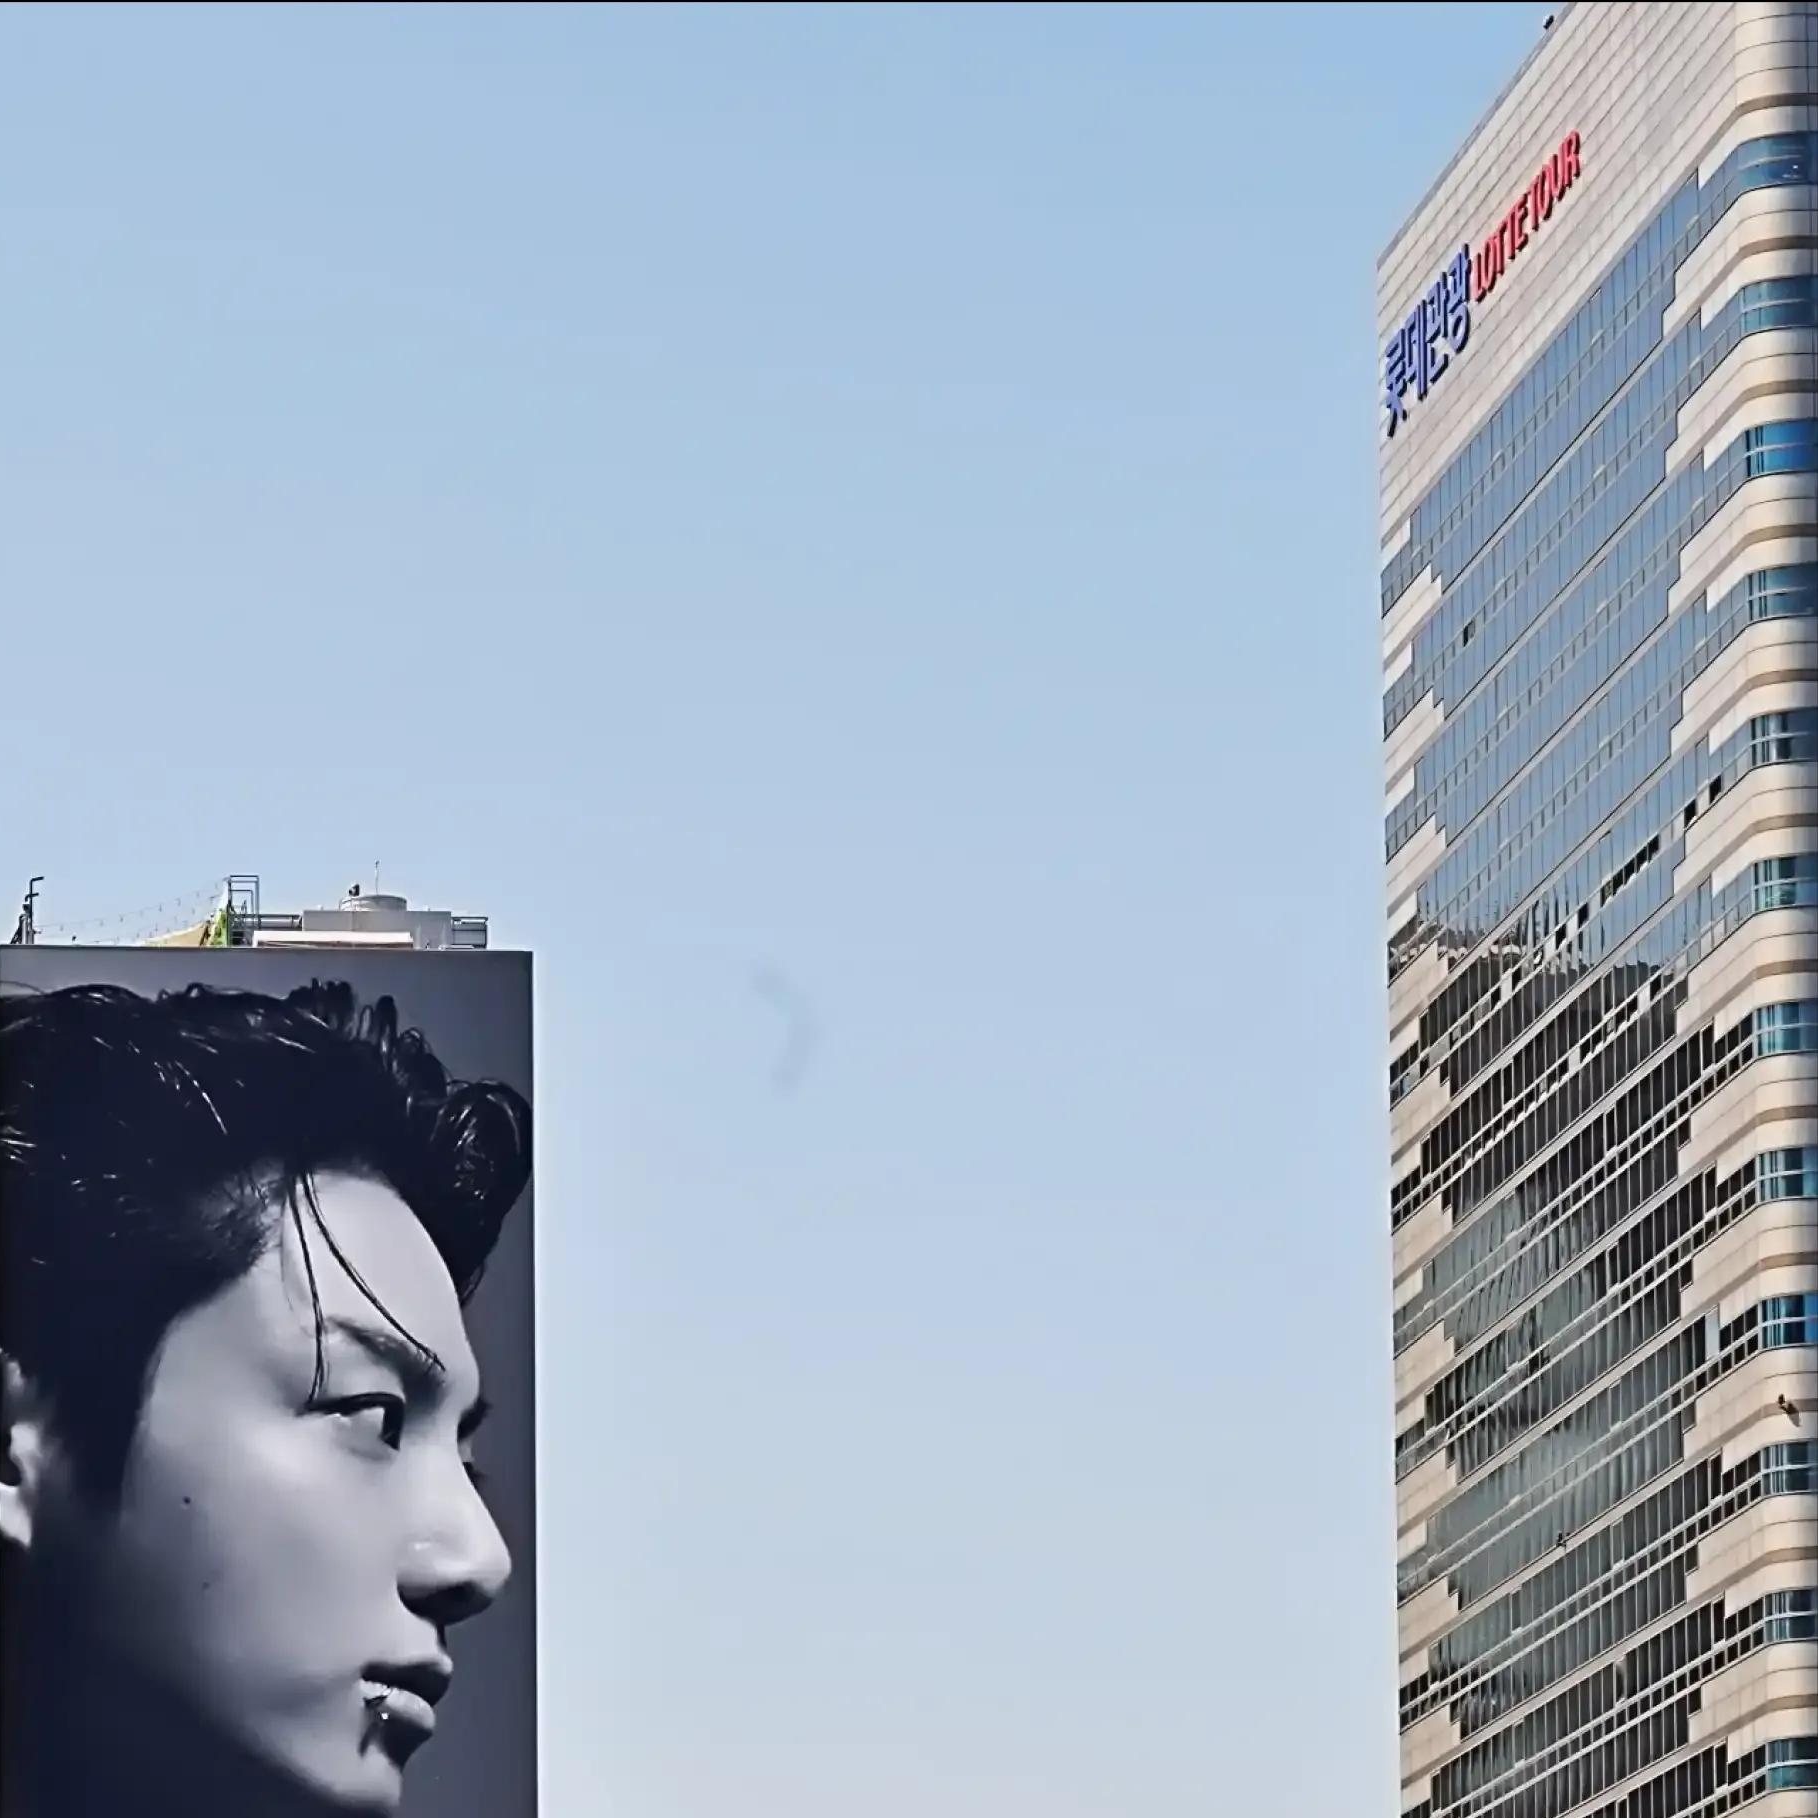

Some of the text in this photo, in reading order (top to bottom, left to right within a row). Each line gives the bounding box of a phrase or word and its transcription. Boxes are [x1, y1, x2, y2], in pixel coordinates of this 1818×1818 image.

[1472, 128, 1581, 304] LOTTE TOUR
[1385, 243, 1472, 438] 롯데관광
